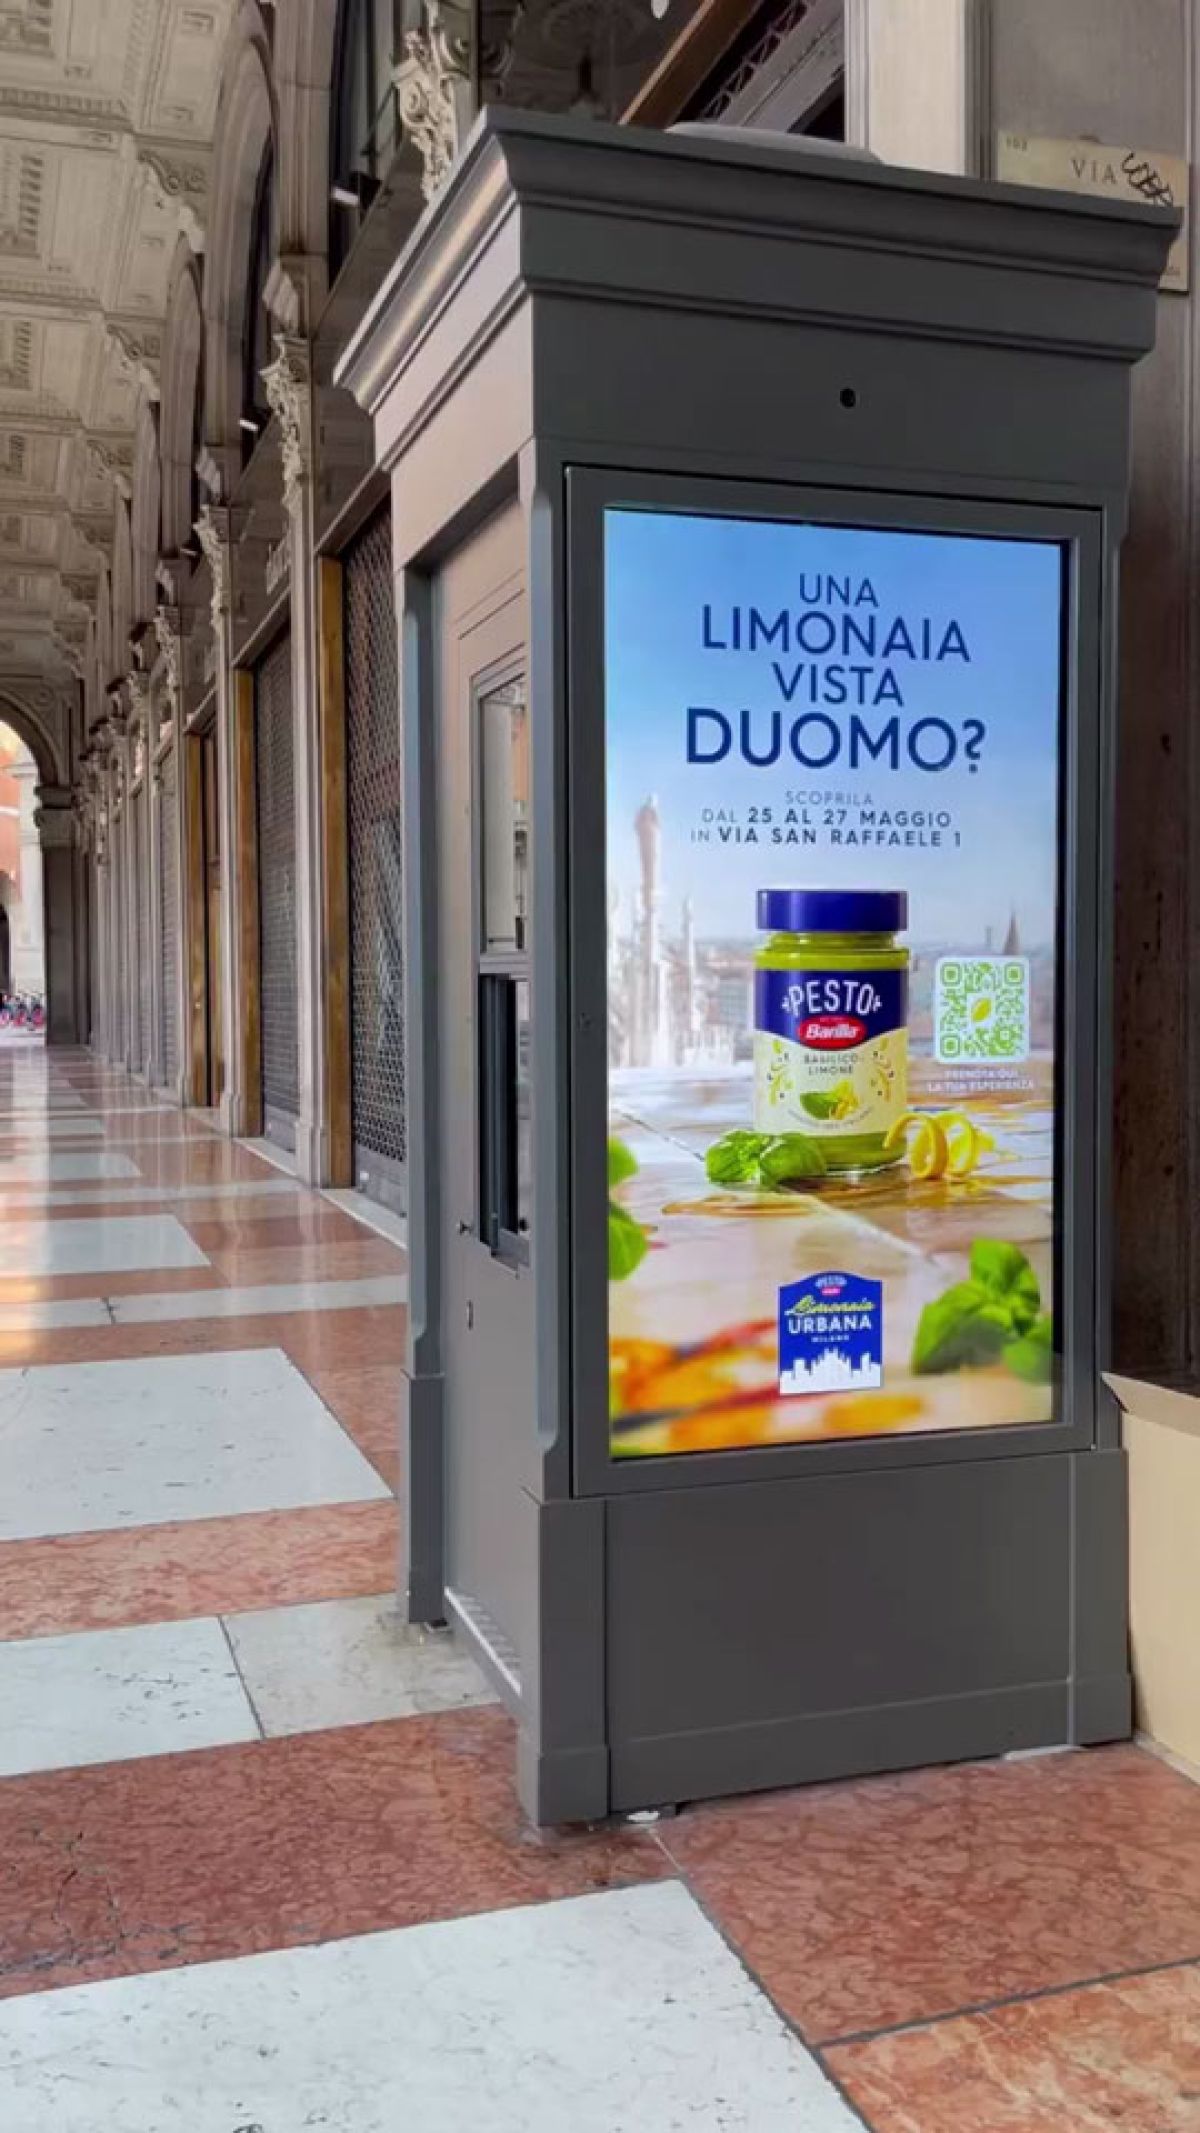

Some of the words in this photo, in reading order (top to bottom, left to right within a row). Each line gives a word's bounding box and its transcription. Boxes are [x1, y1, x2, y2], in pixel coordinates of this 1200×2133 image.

[1071, 158, 1118, 184] VIA
[800, 573, 878, 607] UNA
[703, 604, 971, 662] LIMONAIA
[772, 662, 904, 707] VISTA
[687, 707, 985, 773] DUOMO?
[785, 790, 873, 806] SCOPRILA
[702, 808, 737, 823] DAL
[748, 807, 773, 823] 25
[784, 809, 812, 825] AL
[824, 809, 848, 825] 27
[859, 810, 951, 828] MAGGIO
[691, 829, 710, 842] IN
[718, 826, 759, 843] VIA
[771, 828, 817, 844] SAN
[831, 829, 942, 847] RAFFAELE
[954, 831, 961, 847] 1
[789, 980, 874, 1016] PESTO
[805, 1023, 860, 1040] Barilla
[788, 1315, 872, 1334] URBANA
